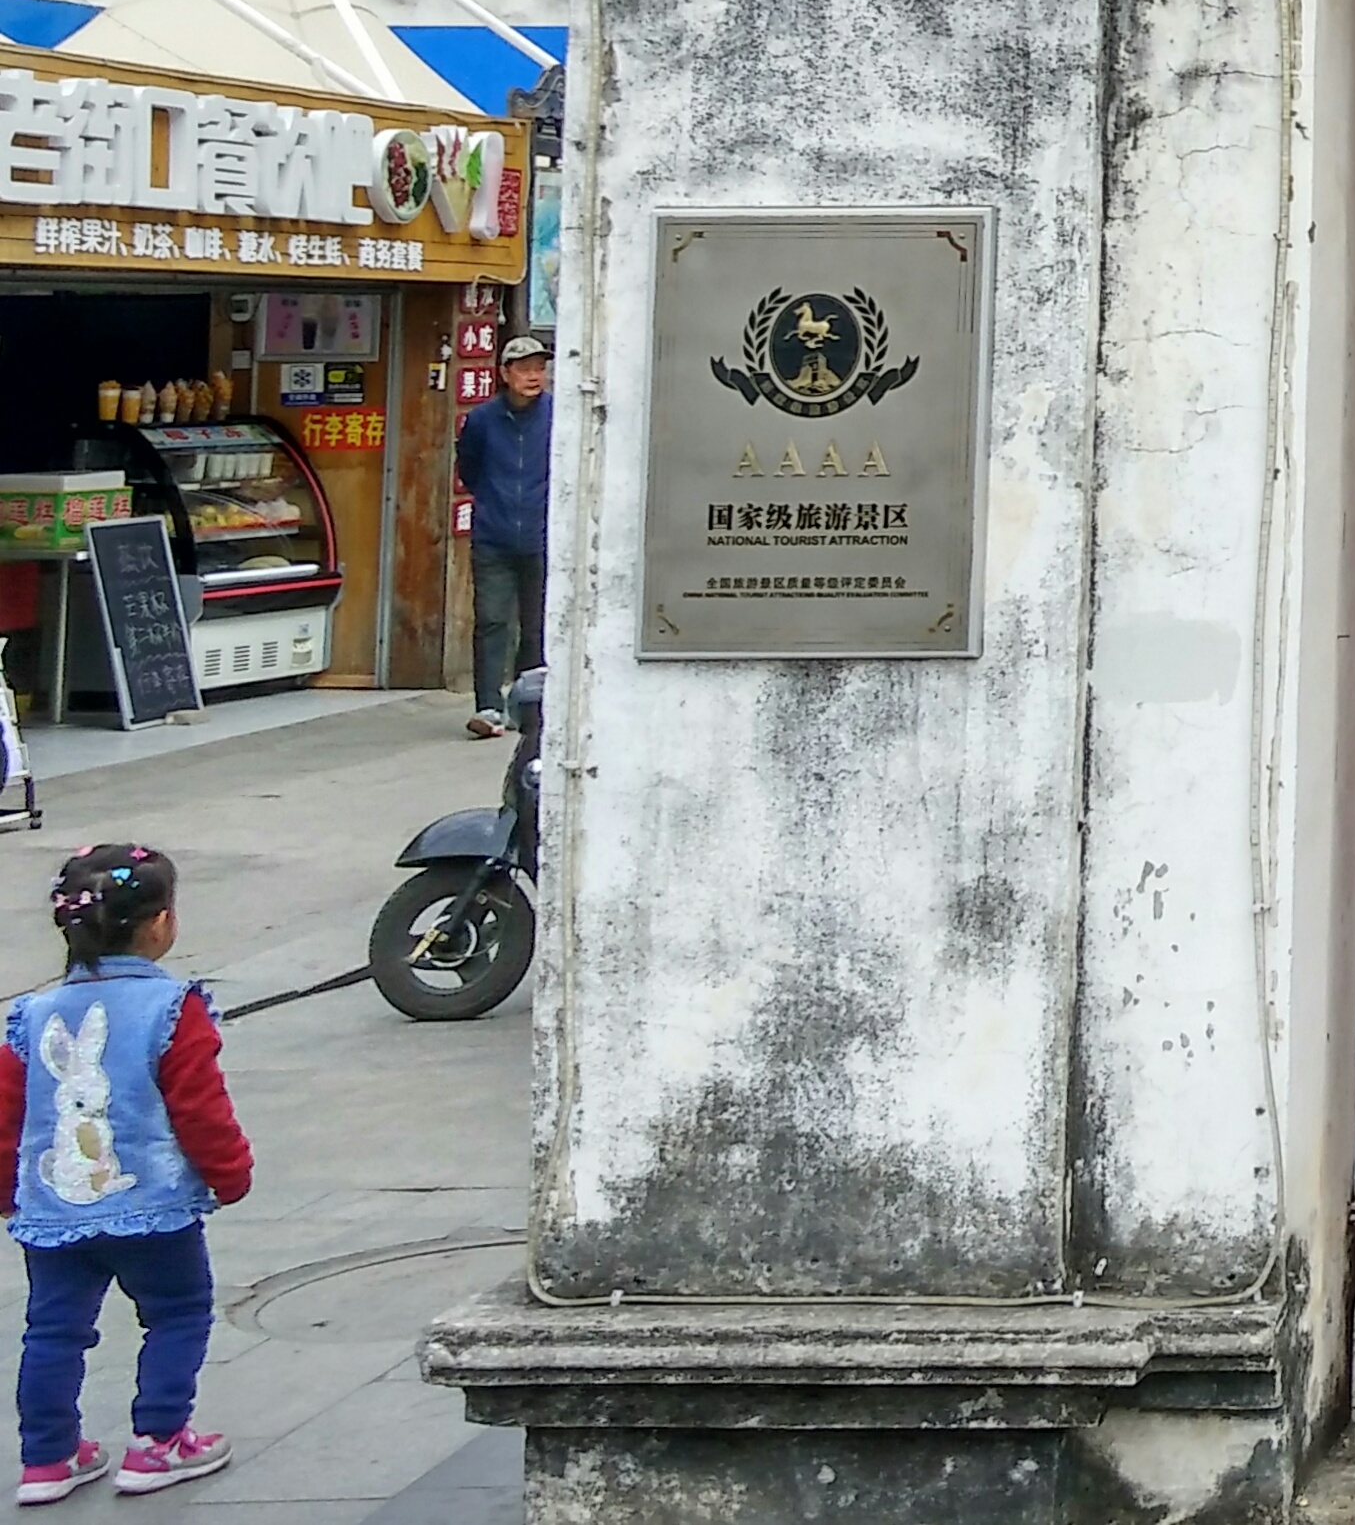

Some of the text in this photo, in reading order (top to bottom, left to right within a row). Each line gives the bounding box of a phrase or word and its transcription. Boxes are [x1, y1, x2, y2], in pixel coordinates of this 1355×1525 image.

[462, 325, 494, 351] 小吃
[461, 370, 493, 398] 果汁
[303, 412, 385, 447] 行李寄存
[708, 503, 909, 531] 国家级旅游景区
[707, 535, 909, 546] NATIONAL TOURIST ATTRACTION
